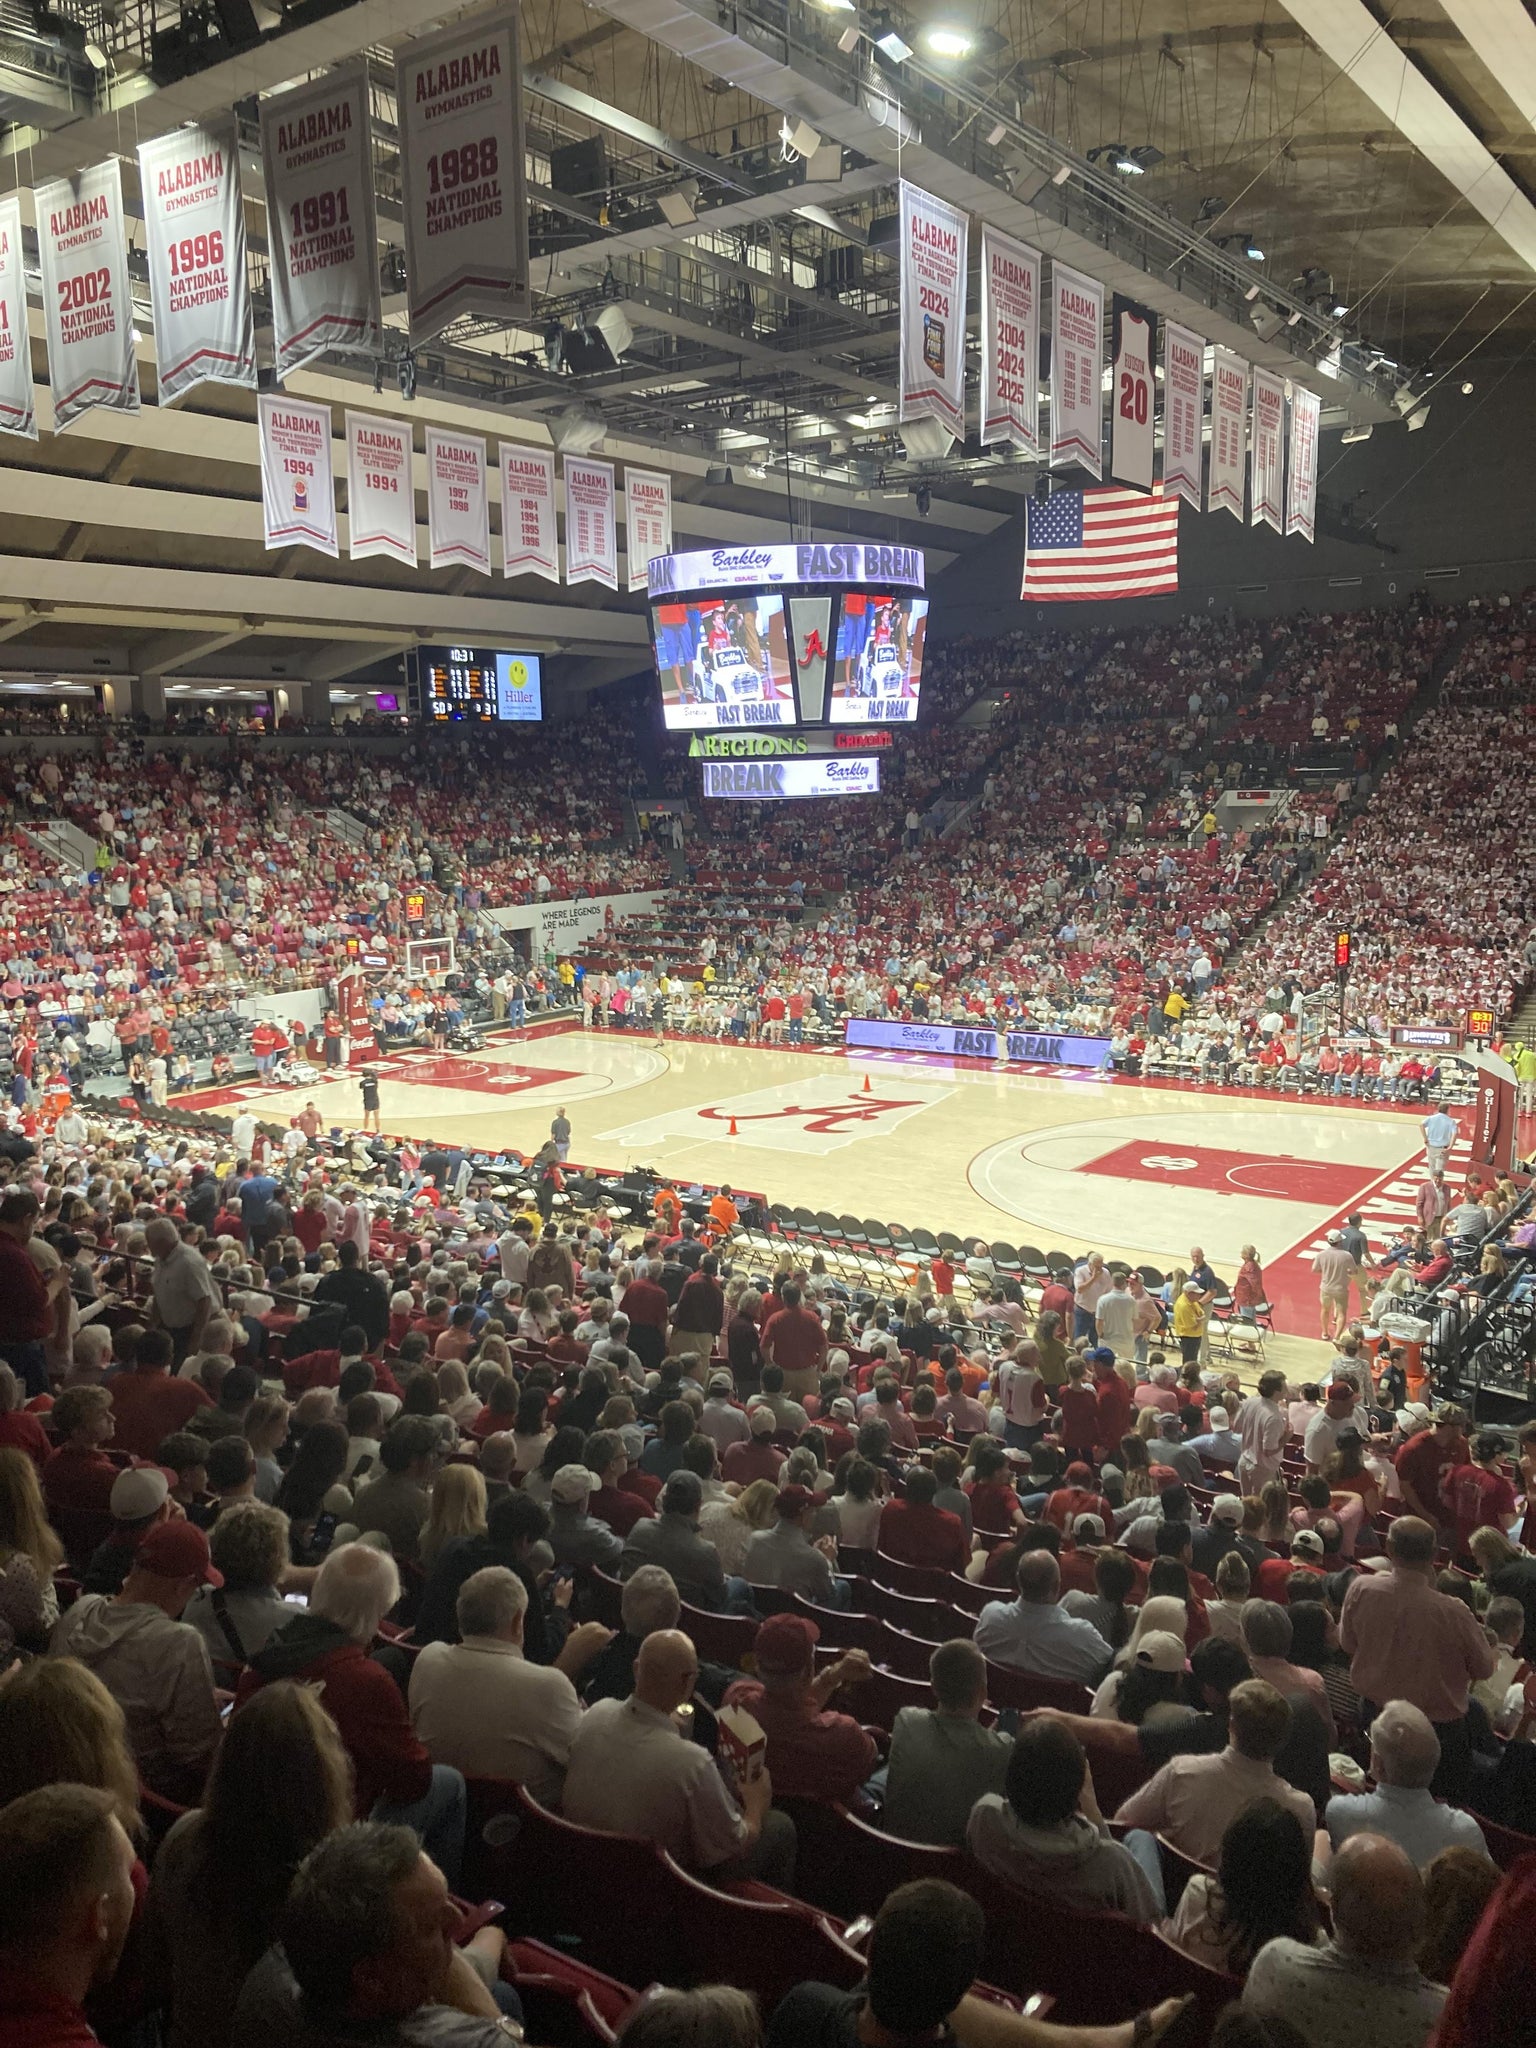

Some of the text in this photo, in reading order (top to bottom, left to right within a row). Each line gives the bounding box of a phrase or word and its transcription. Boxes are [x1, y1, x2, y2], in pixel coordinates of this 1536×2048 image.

[416, 45, 500, 103] ALABAMA
[425, 84, 492, 120] GYMNASTICS
[278, 102, 352, 153] ALABAMA
[287, 138, 345, 169] GYMNASTICS
[158, 151, 224, 196] ALABAMA
[428, 136, 498, 194] 1988
[166, 185, 218, 212] GYMNASTICS
[426, 180, 501, 218] NATIONAL
[50, 195, 109, 236] ALABAMA
[290, 187, 349, 238] 1991
[427, 200, 502, 236] CHAMPIONS
[58, 227, 102, 251] GYMNASTICS
[289, 226, 355, 261] NATIONAL
[913, 215, 957, 257] ALABAMA
[168, 230, 224, 276] 1996
[291, 245, 355, 277] CHAMPIONS
[912, 250, 957, 277] NCAA TOURNAMENT
[928, 248, 957, 269] BASKETBALL
[170, 268, 228, 296] NATIONAL
[918, 264, 951, 287] FINAL FOUR
[992, 254, 1031, 292] ALABAMA
[58, 267, 111, 312] 2002
[170, 285, 229, 312] CHAMPIONS
[920, 286, 949, 318] 2024
[996, 298, 1027, 320] ELITE EIGHT
[1061, 288, 1095, 322] ALABAMA
[61, 303, 114, 330] NATIONAL
[62, 319, 115, 344] CHAMPIONS
[998, 320, 1025, 350] 2004
[1060, 327, 1095, 350] SWEET SIXTEEN
[998, 348, 1024, 378] 2024
[1125, 353, 1145, 375] HUDSON
[1172, 344, 1198, 372] ALABAMA
[998, 376, 1024, 405] 2025
[1219, 368, 1242, 392] ALABAMA
[1120, 372, 1147, 425] 20
[1260, 387, 1280, 409] ALABAMA
[272, 412, 321, 435] ALABAMA
[280, 444, 316, 456] FINAL FOUR
[288, 439, 322, 450] TOURNAMENT
[358, 430, 402, 452] ALABAMA
[363, 459, 398, 471] ELITE EIGHT
[372, 454, 404, 465] TOURNAMENT
[437, 445, 477, 465] ALABAMA
[284, 458, 313, 476] 1994
[450, 468, 478, 478] TOURNAMENT
[509, 460, 546, 478] ALABAMA
[366, 473, 398, 492] 1994
[437, 472, 479, 485] SWEET SIXTEEN
[573, 472, 607, 489] ALABAMA
[449, 487, 467, 499] 1997
[509, 485, 547, 496] SWEET SIXTEEN
[633, 483, 664, 500] ALABAMA
[450, 500, 468, 512] 1998
[521, 499, 537, 510] 1984
[575, 497, 606, 507] APPEARANCES
[521, 512, 538, 523] 1994
[522, 524, 539, 535] 1995
[522, 536, 539, 547] 1996
[712, 549, 772, 568] Barkley
[797, 545, 919, 583] FAST BREAK
[1388, 582, 1396, 594] Q
[451, 649, 474, 662] 10:31
[505, 691, 533, 702] Hiller
[433, 702, 445, 714] 50
[485, 703, 496, 715] 31
[716, 705, 740, 724] FAST
[744, 703, 781, 723] BREAK
[868, 700, 884, 719] FAST
[886, 700, 909, 719] BREAK
[704, 735, 808, 757] REGIONS
[711, 764, 784, 794] BREAK
[826, 762, 869, 778] Barkley
[542, 906, 600, 920] WHERE LEGENDS
[543, 918, 579, 929] ARE MADE
[351, 1018, 368, 1026] YETI
[1473, 1021, 1488, 1032] 30
[350, 1036, 375, 1050] Coca-Cola
[902, 1027, 940, 1042] Barkley
[954, 1030, 996, 1054] FAST
[1482, 1096, 1494, 1142] Hiller
